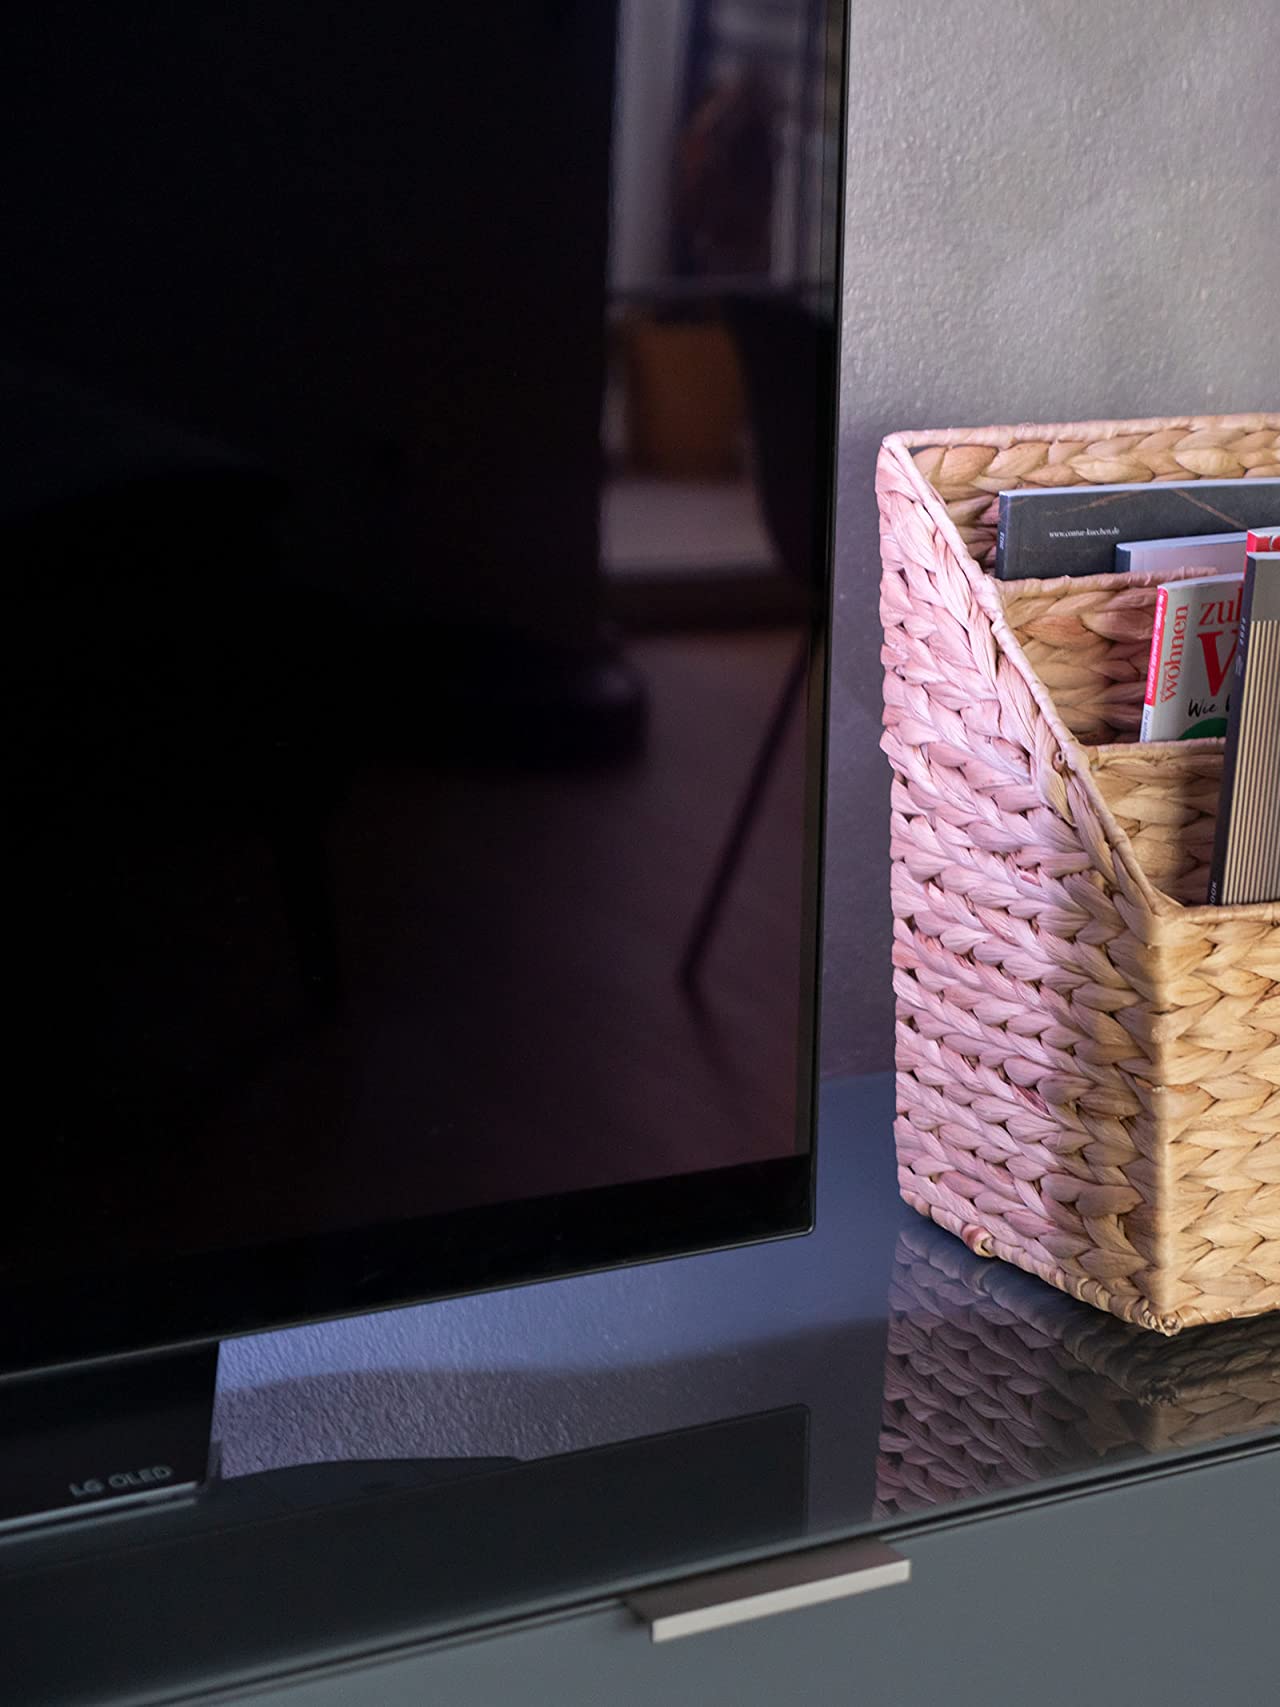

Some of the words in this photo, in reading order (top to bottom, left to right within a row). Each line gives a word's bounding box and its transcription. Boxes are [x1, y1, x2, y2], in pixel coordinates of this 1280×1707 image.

[1163, 605, 1189, 701] wohnen
[69, 1479, 104, 1497] LG
[108, 1465, 174, 1488] OLED
